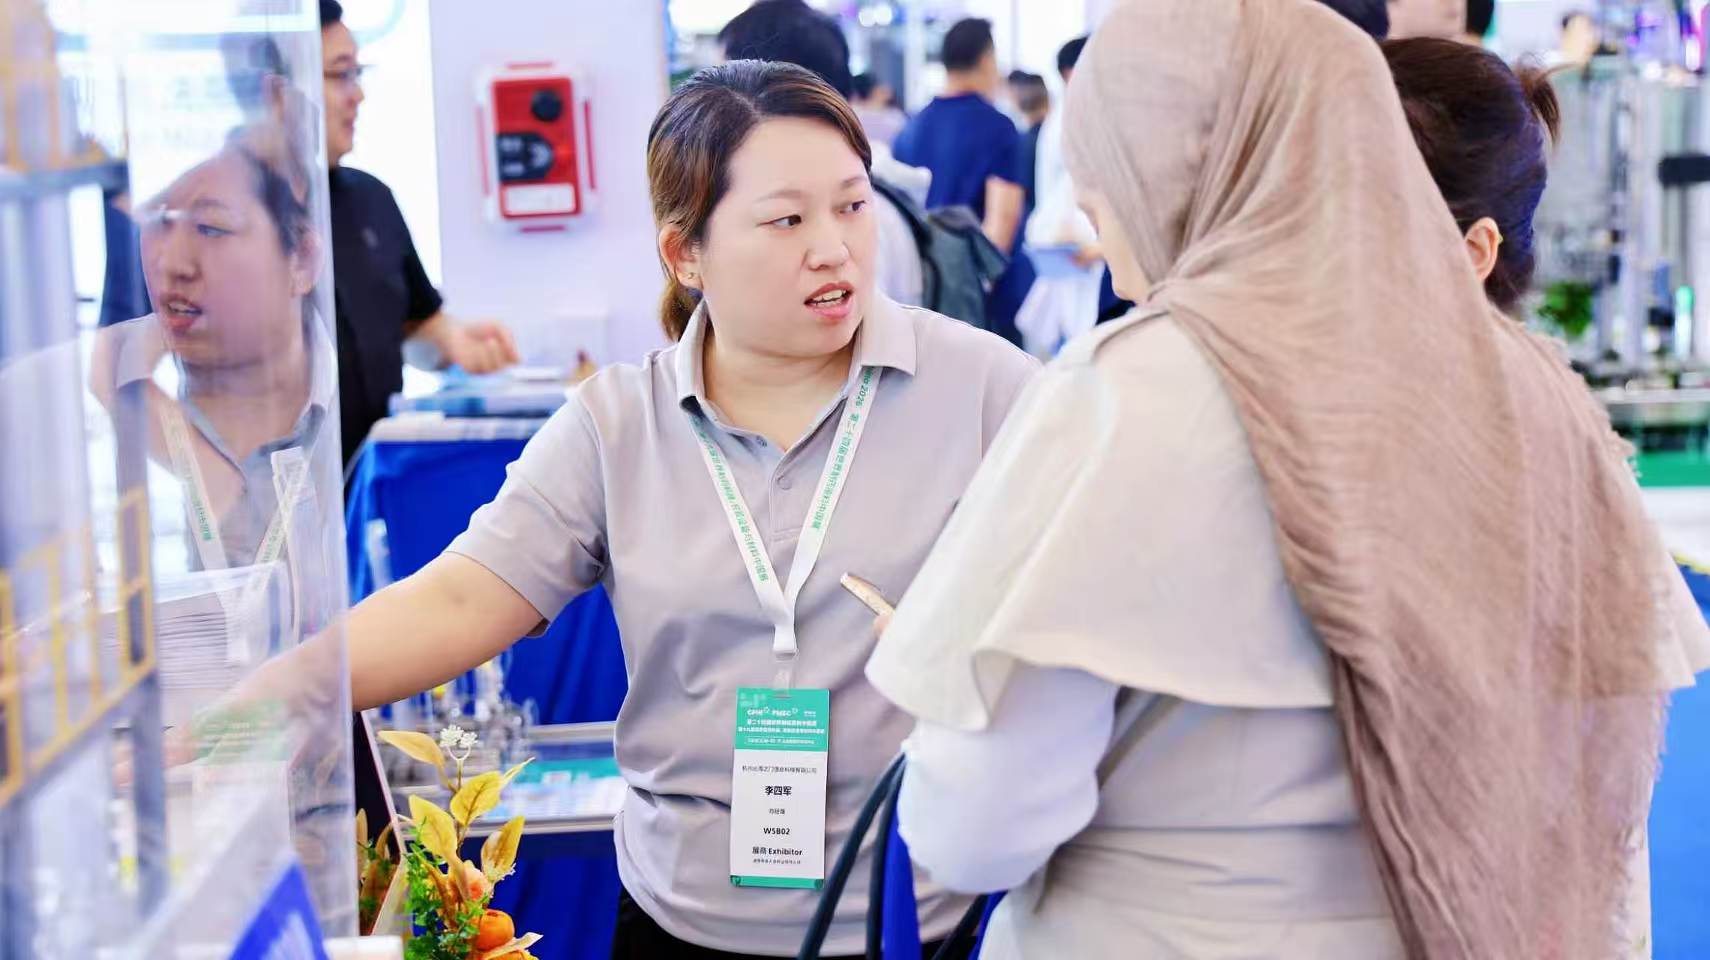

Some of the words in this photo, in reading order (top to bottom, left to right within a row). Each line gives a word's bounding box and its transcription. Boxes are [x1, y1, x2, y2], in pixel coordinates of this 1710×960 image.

[765, 785, 792, 796] 李四军
[763, 827, 790, 835] W5B02
[768, 847, 802, 856] Exhibitor
